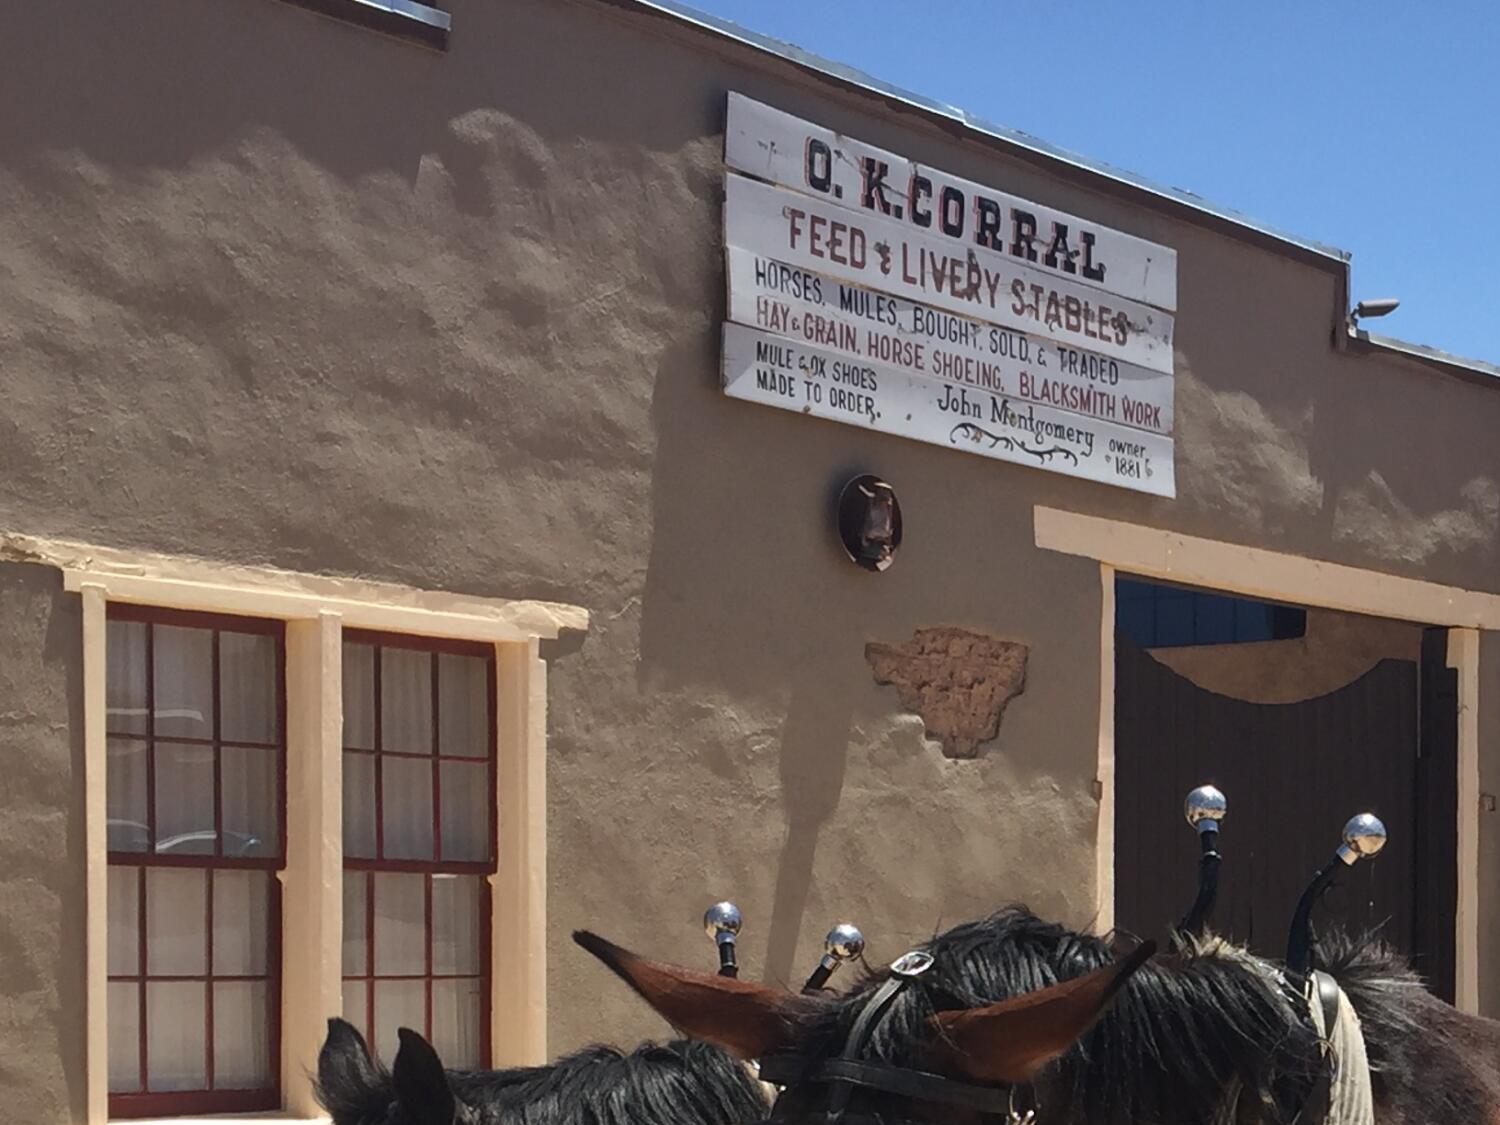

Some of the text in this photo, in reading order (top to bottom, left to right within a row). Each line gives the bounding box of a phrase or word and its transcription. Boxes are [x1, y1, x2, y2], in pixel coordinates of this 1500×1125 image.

[789, 208, 1128, 347] FEED & LIVERY STABLES
[756, 340, 878, 392] MULE & OX SHOES
[756, 369, 796, 398] MADE
[804, 380, 822, 404] TO
[757, 296, 790, 333] HAY
[791, 317, 801, 331] &
[868, 331, 925, 371] HORSE
[1019, 371, 1116, 419] BLACKSMITH
[1121, 394, 1162, 429] WORK
[1037, 347, 1047, 368] &
[1056, 346, 1119, 386] TRADED
[937, 384, 1095, 457] John Montgomery
